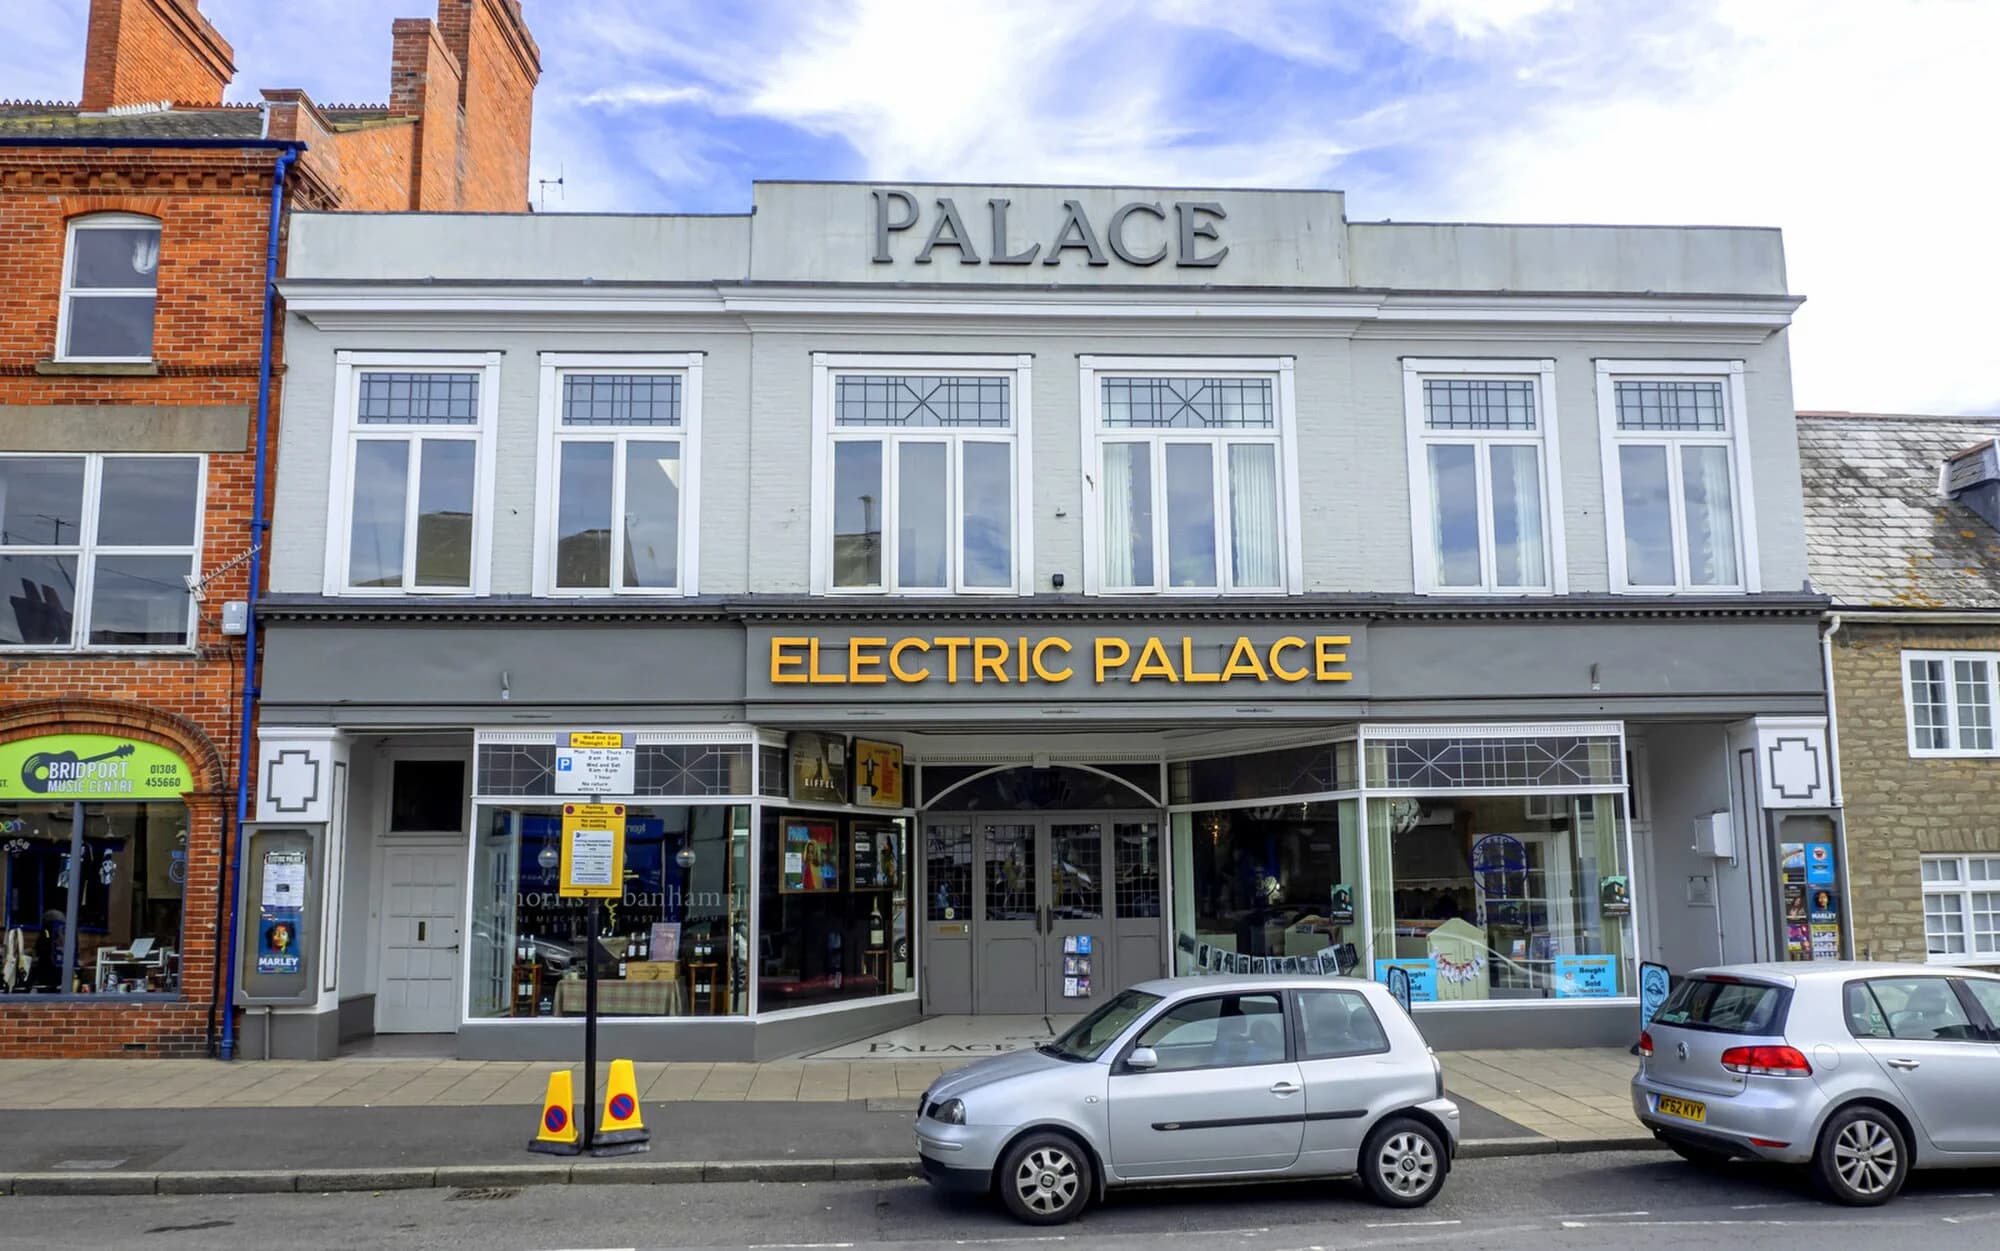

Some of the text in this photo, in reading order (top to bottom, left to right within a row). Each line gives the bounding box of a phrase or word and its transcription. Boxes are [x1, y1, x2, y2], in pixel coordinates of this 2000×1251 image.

[872, 189, 1229, 268] PALACE
[770, 635, 1353, 684] ELECTRIC PALACE
[49, 761, 129, 779] BRIDPORT
[150, 764, 177, 775] 01308
[47, 779, 135, 794] MUSIC CENTRE
[145, 777, 181, 788] 455660
[623, 883, 721, 908] banham
[258, 957, 299, 967] MARLEY
[868, 1042, 1016, 1053] PALACE
[1684, 1102, 1704, 1119] KVY
